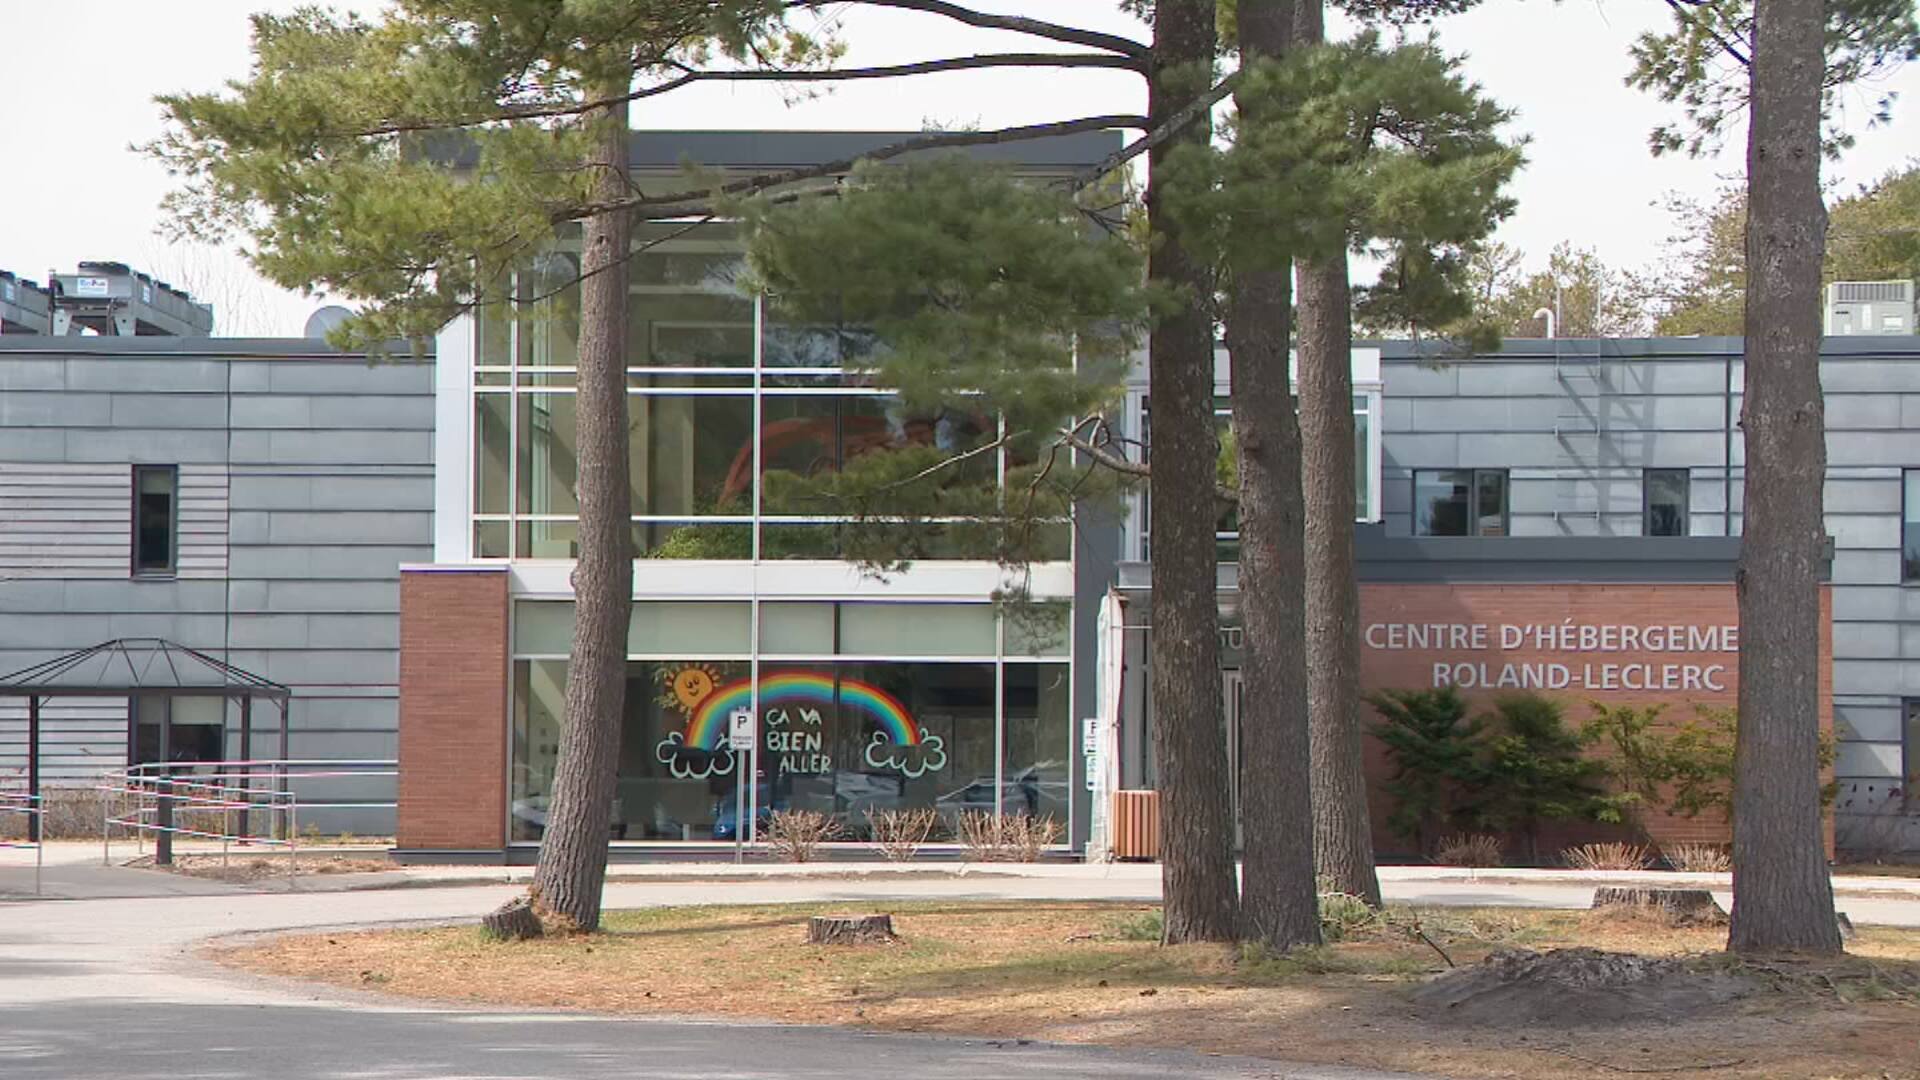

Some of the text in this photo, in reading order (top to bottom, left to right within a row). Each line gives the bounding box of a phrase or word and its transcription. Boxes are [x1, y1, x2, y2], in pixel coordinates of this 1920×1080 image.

[1365, 617, 1739, 651] CENTRE D'HÉBERGEME
[1433, 662, 1725, 690] ROLAND-LECLERC
[737, 715, 748, 729] P
[766, 707, 822, 728] ÇA VA
[766, 731, 822, 751] BIEN
[779, 754, 832, 774] ALLER
